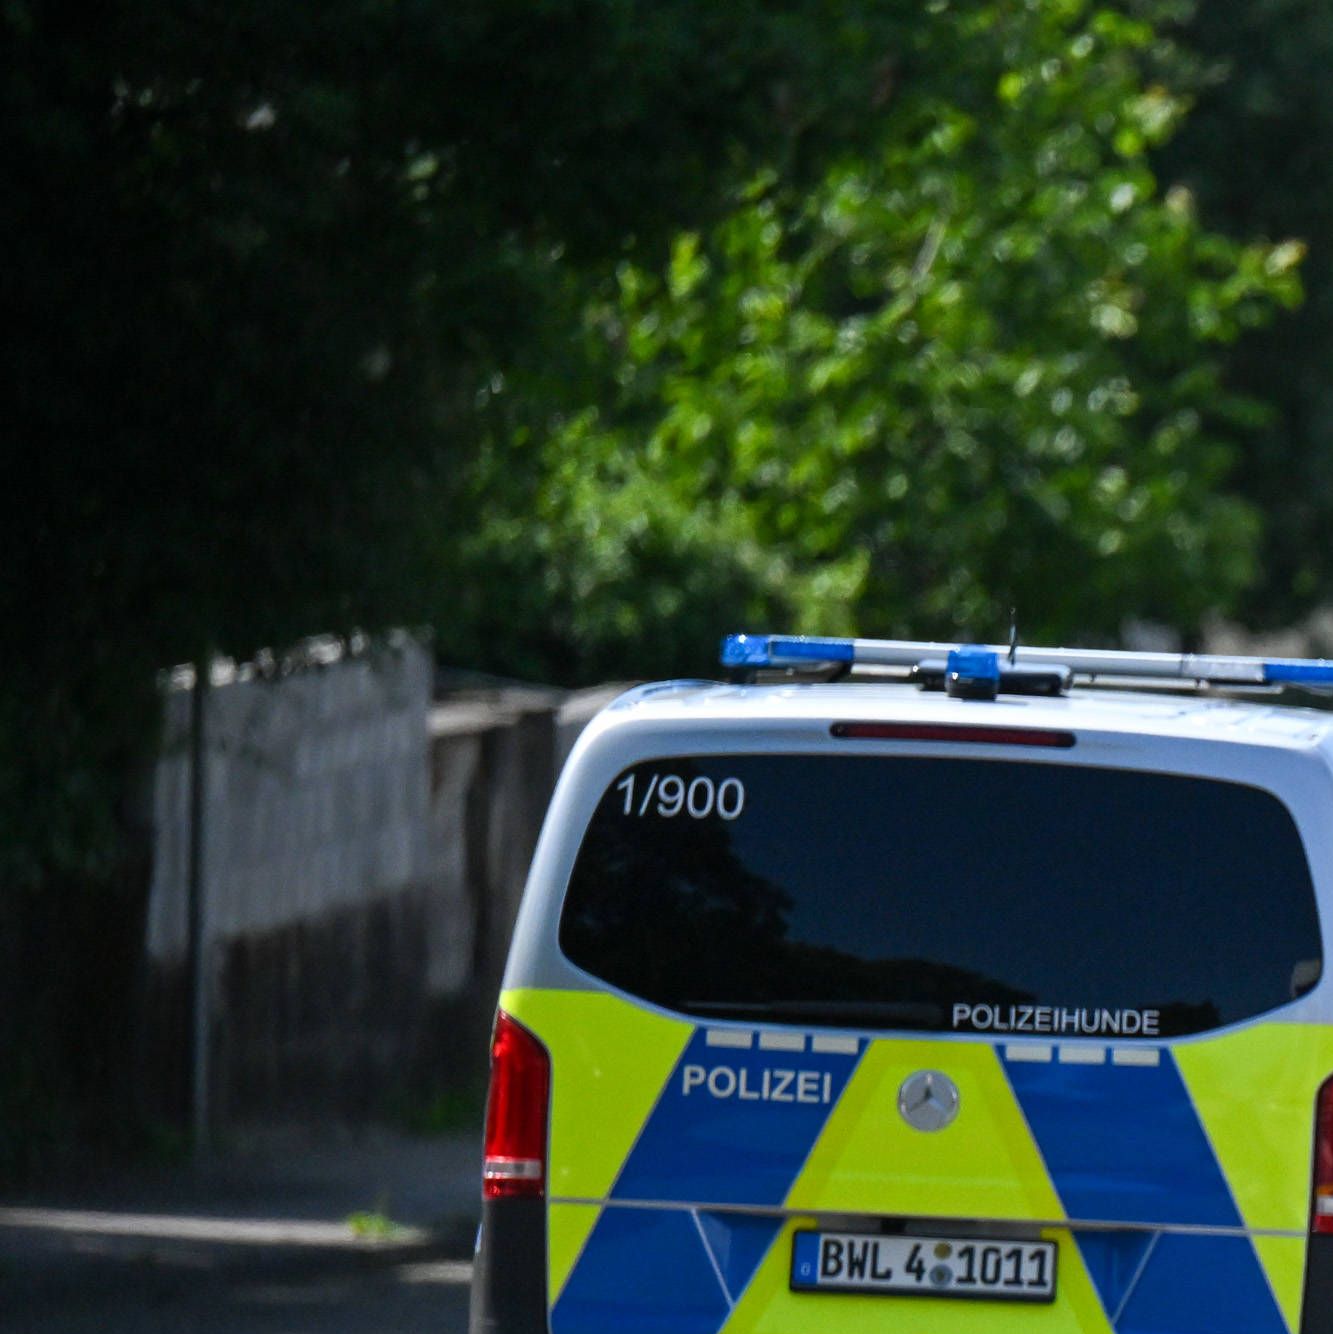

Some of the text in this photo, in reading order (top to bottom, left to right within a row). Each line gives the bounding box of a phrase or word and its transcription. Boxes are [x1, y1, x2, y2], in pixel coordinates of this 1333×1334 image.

[617, 773, 744, 820] 1/900
[952, 1003, 1160, 1035] POLIZEIHUNDE
[682, 1065, 832, 1104] POLIZEI
[821, 1239, 892, 1280] BWL
[956, 1246, 1048, 1286] 1011
